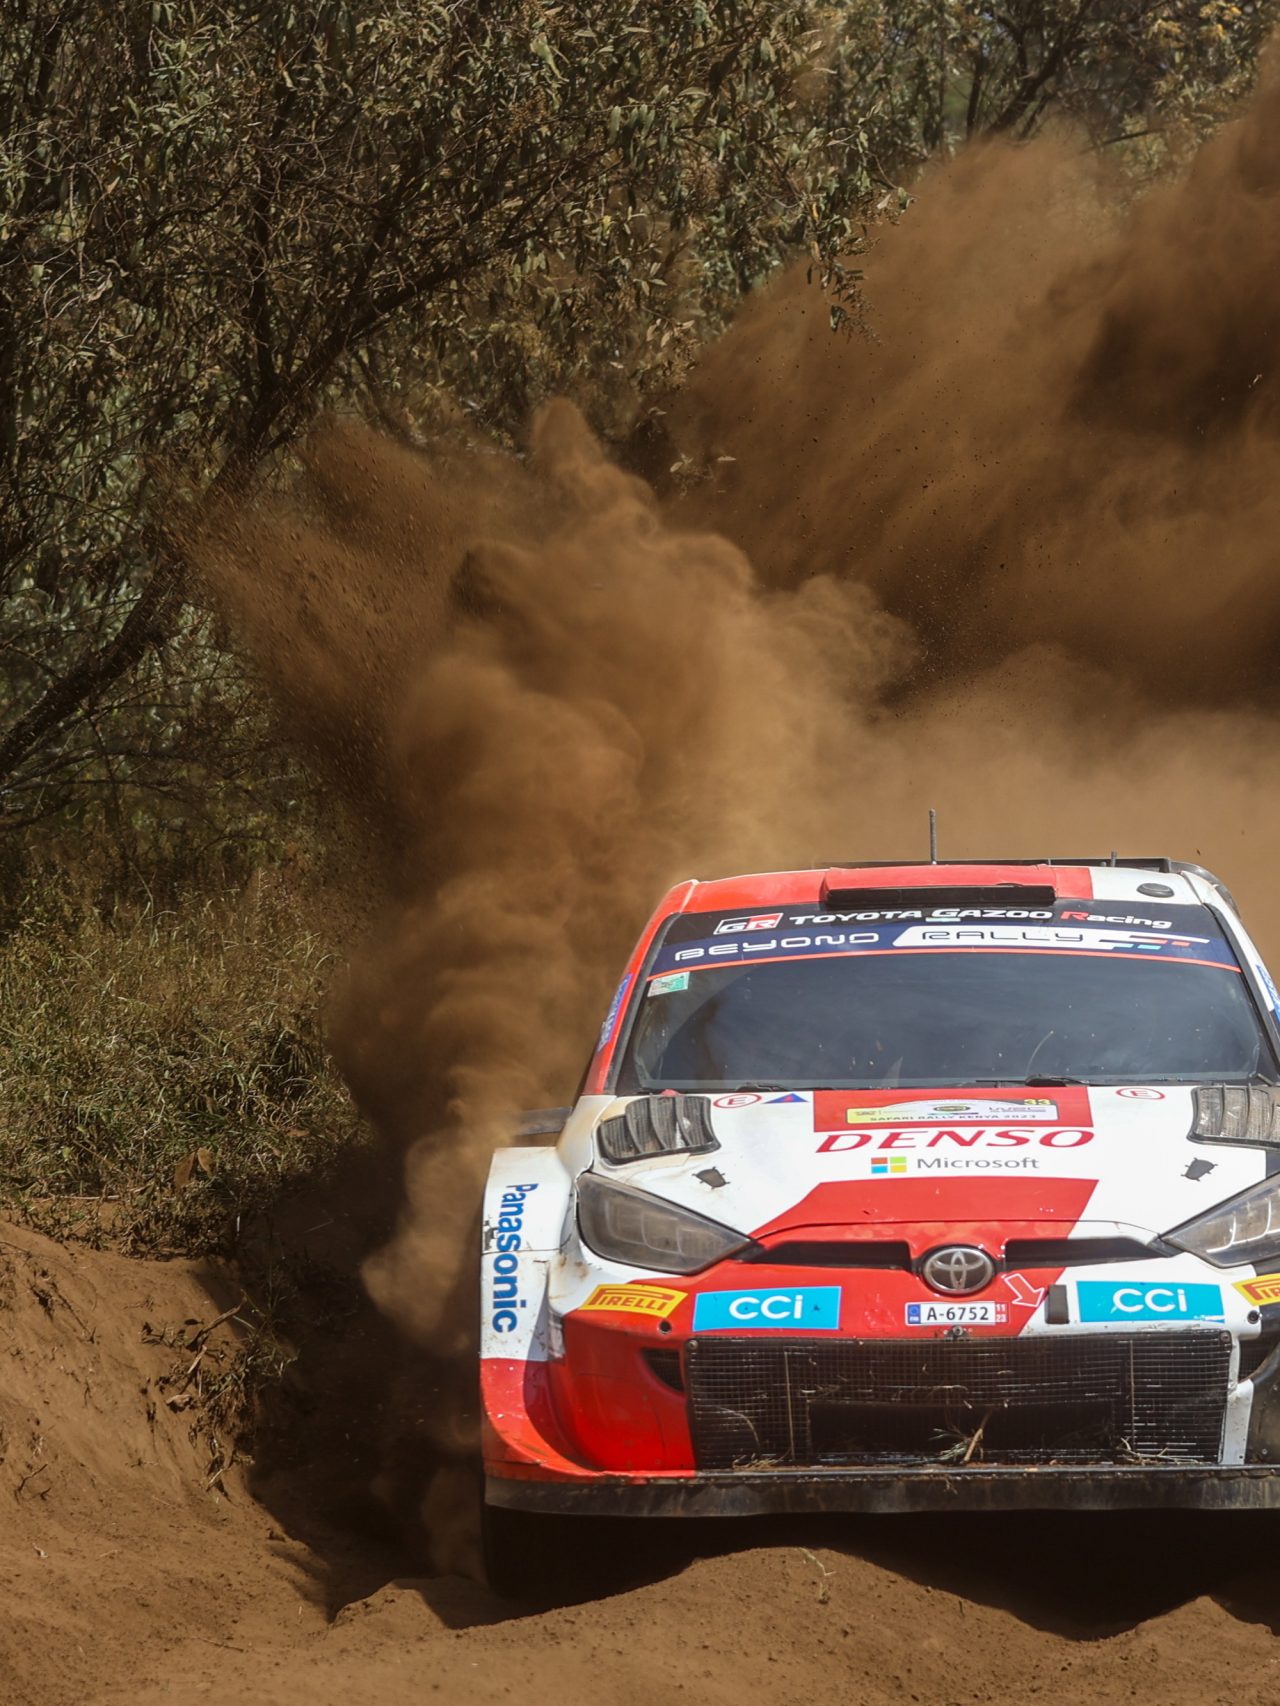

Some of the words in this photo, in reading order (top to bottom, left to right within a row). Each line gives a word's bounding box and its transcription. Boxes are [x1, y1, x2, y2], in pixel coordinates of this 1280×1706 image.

[719, 918, 777, 933] GR
[789, 910, 922, 925] TOYOTA
[931, 908, 1053, 919] GAZOO
[1060, 911, 1173, 929] Racing
[674, 932, 880, 961] BEYOND
[922, 930, 1084, 942] RALLY
[815, 1129, 1095, 1153] DENSO
[917, 1157, 1040, 1169] Microsoft
[492, 1183, 539, 1333] Panasonic
[589, 1289, 675, 1312] PIRELLI
[926, 1306, 989, 1321] A-6752
